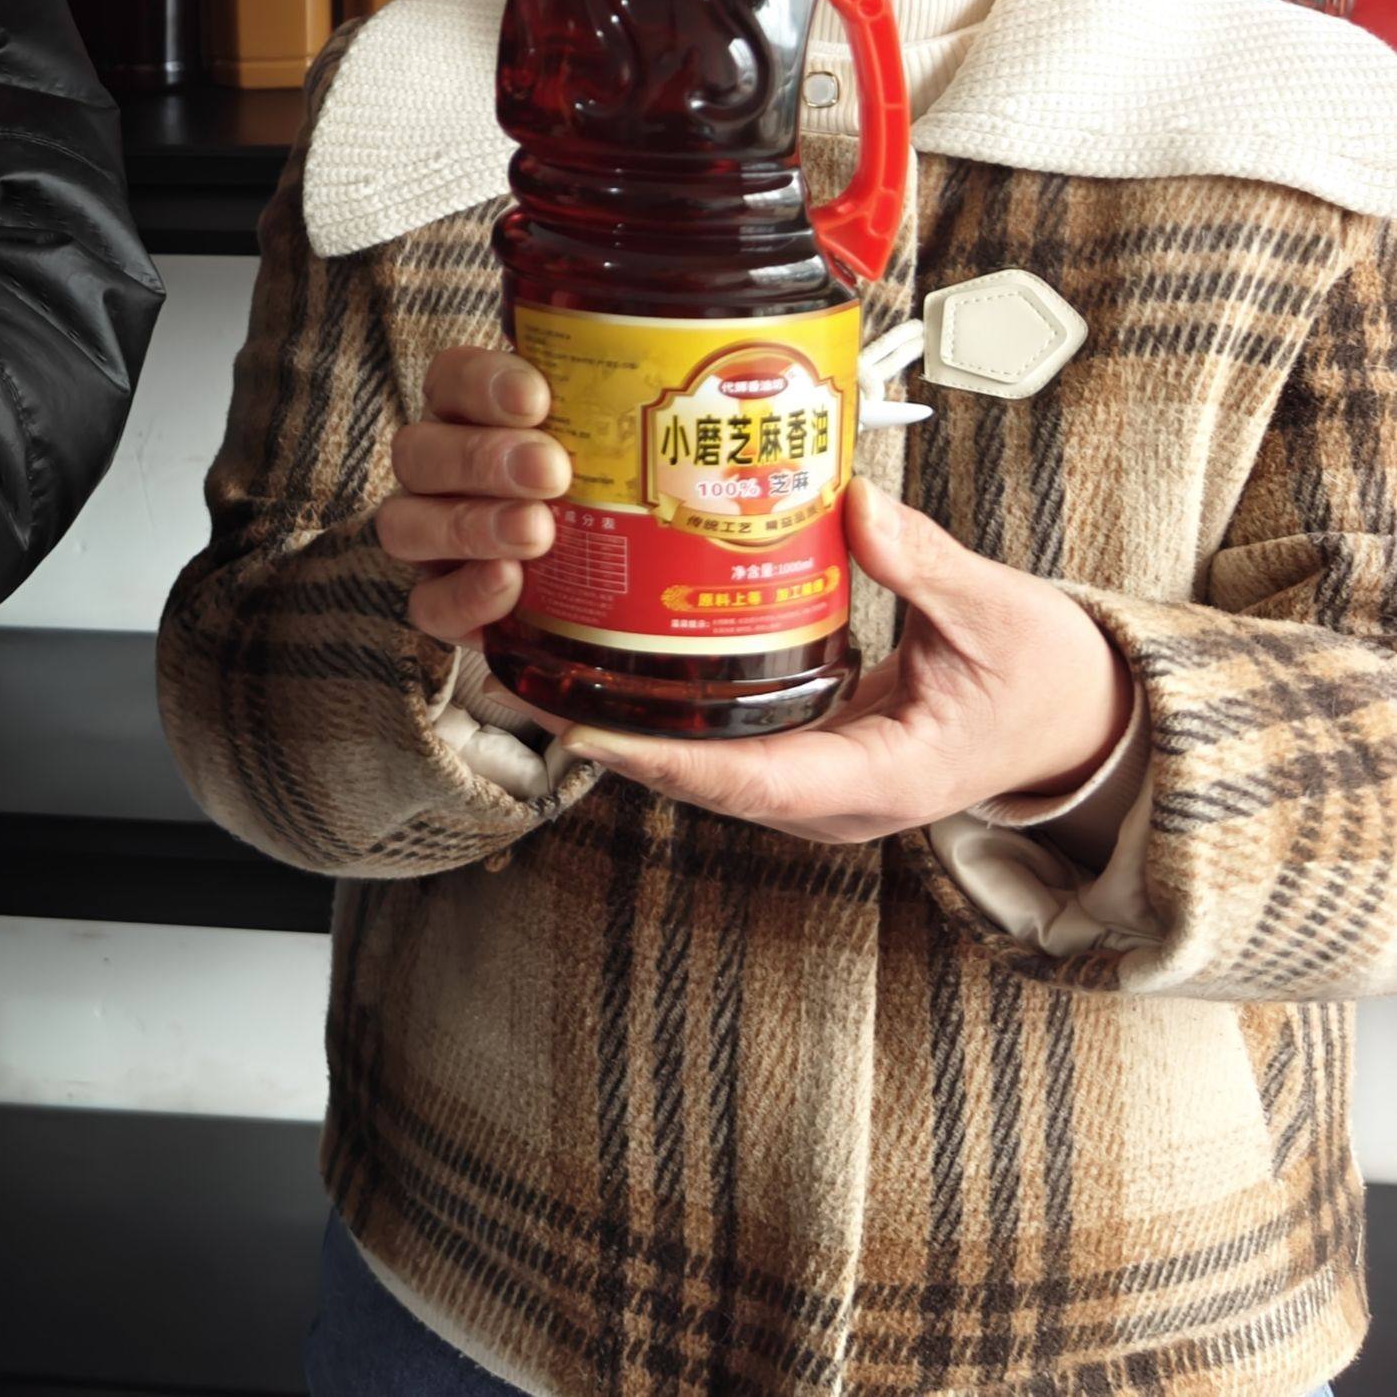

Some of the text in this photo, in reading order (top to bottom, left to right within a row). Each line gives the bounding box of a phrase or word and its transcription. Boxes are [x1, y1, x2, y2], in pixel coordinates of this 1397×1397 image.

[660, 404, 829, 466] 小磨芝麻香油
[698, 470, 810, 497] 100% 芝麻
